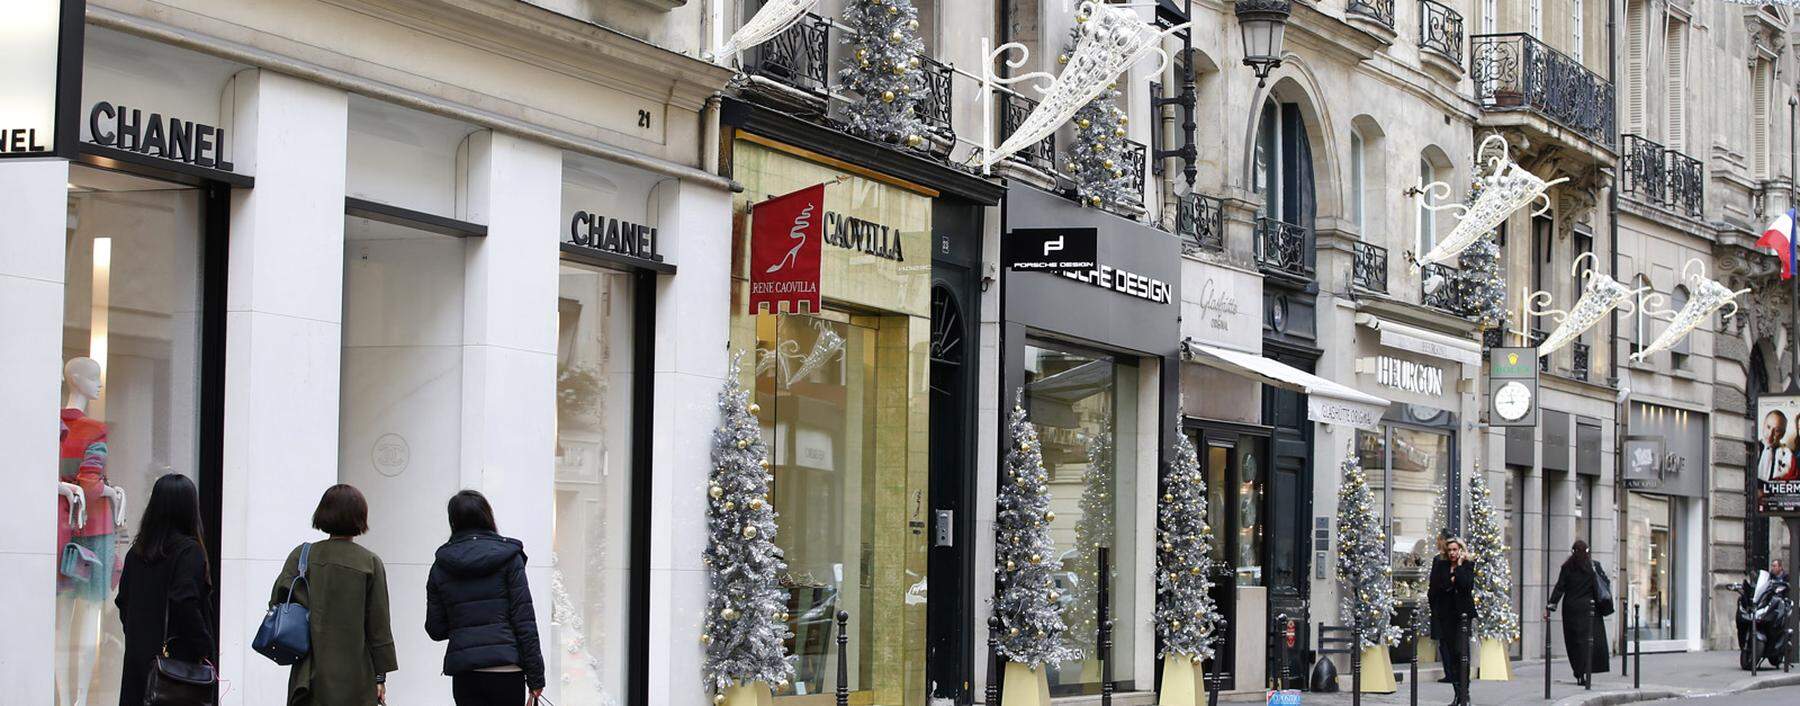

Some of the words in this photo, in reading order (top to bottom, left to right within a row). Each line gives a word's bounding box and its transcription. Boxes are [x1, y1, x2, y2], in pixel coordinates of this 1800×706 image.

[89, 101, 234, 172] CHANEL
[638, 109, 650, 129] 21
[571, 210, 664, 263] CHANEL
[823, 211, 904, 262] CAOVILLA
[775, 280, 817, 293] CAOVILLA
[1115, 269, 1172, 305] DESIGN
[1377, 355, 1443, 396] HEURGON
